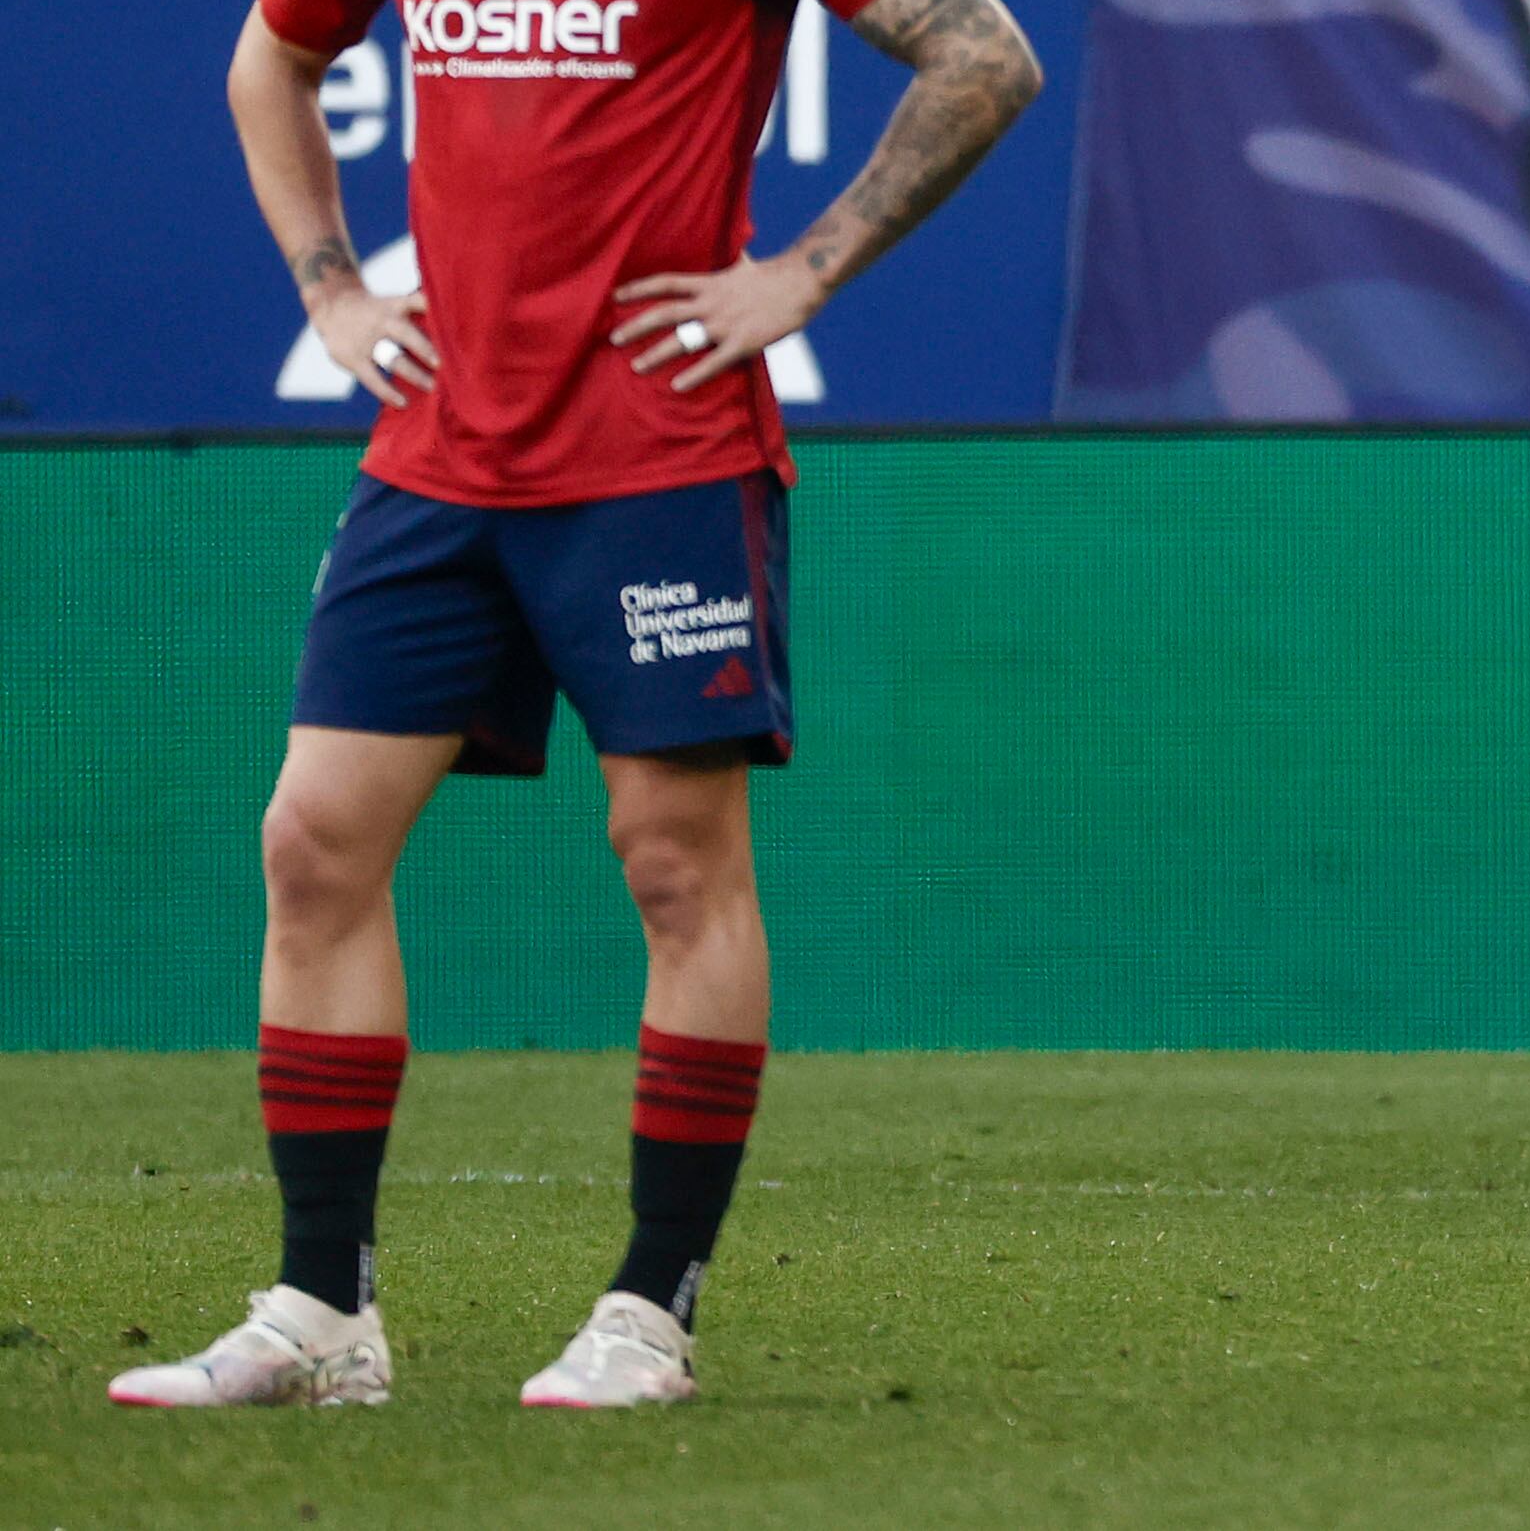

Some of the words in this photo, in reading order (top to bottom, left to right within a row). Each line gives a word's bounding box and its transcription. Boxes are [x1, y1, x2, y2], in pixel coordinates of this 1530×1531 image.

[625, 593, 753, 638] Universidad
[629, 637, 660, 665] de
[660, 625, 751, 659] Navarra
